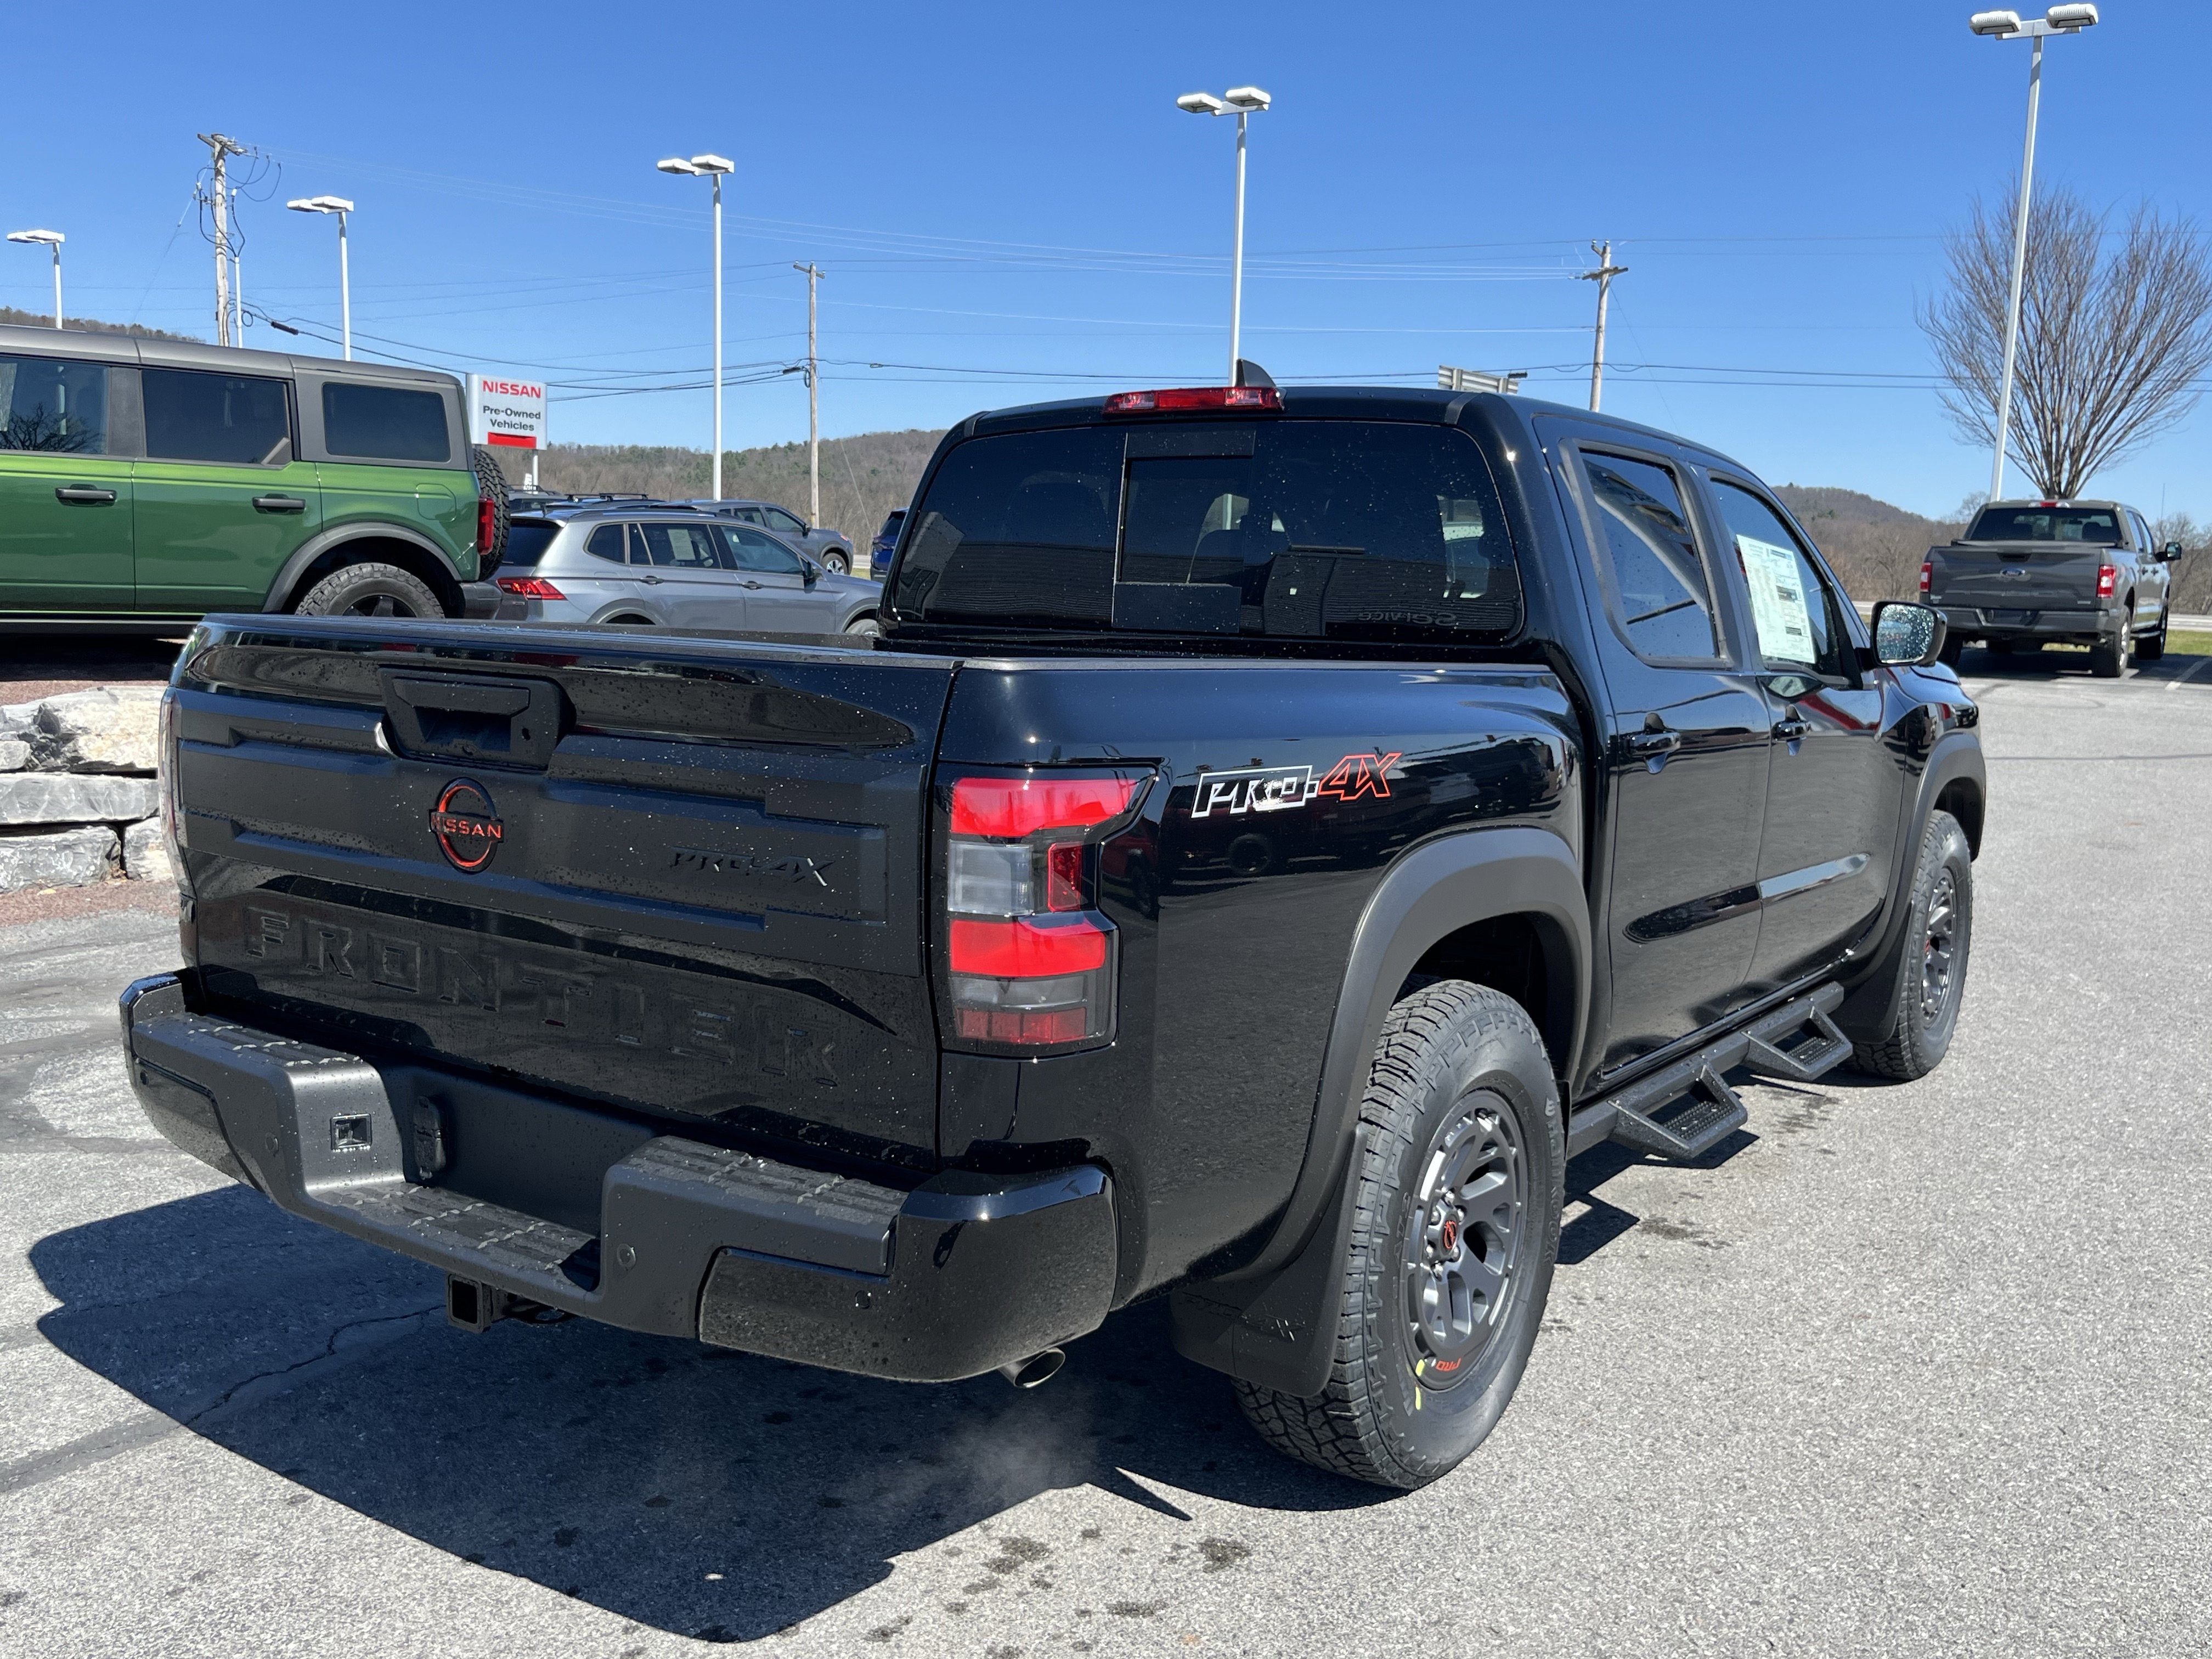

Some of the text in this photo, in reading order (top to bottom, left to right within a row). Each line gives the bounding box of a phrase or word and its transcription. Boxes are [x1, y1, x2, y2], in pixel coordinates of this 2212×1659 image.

[482, 380, 541, 399] NISSAN
[483, 405, 541, 420] Pre-Owned
[490, 418, 535, 431] Vehicles
[431, 814, 502, 839] NISSAN
[246, 905, 839, 1087] FRONTIER
